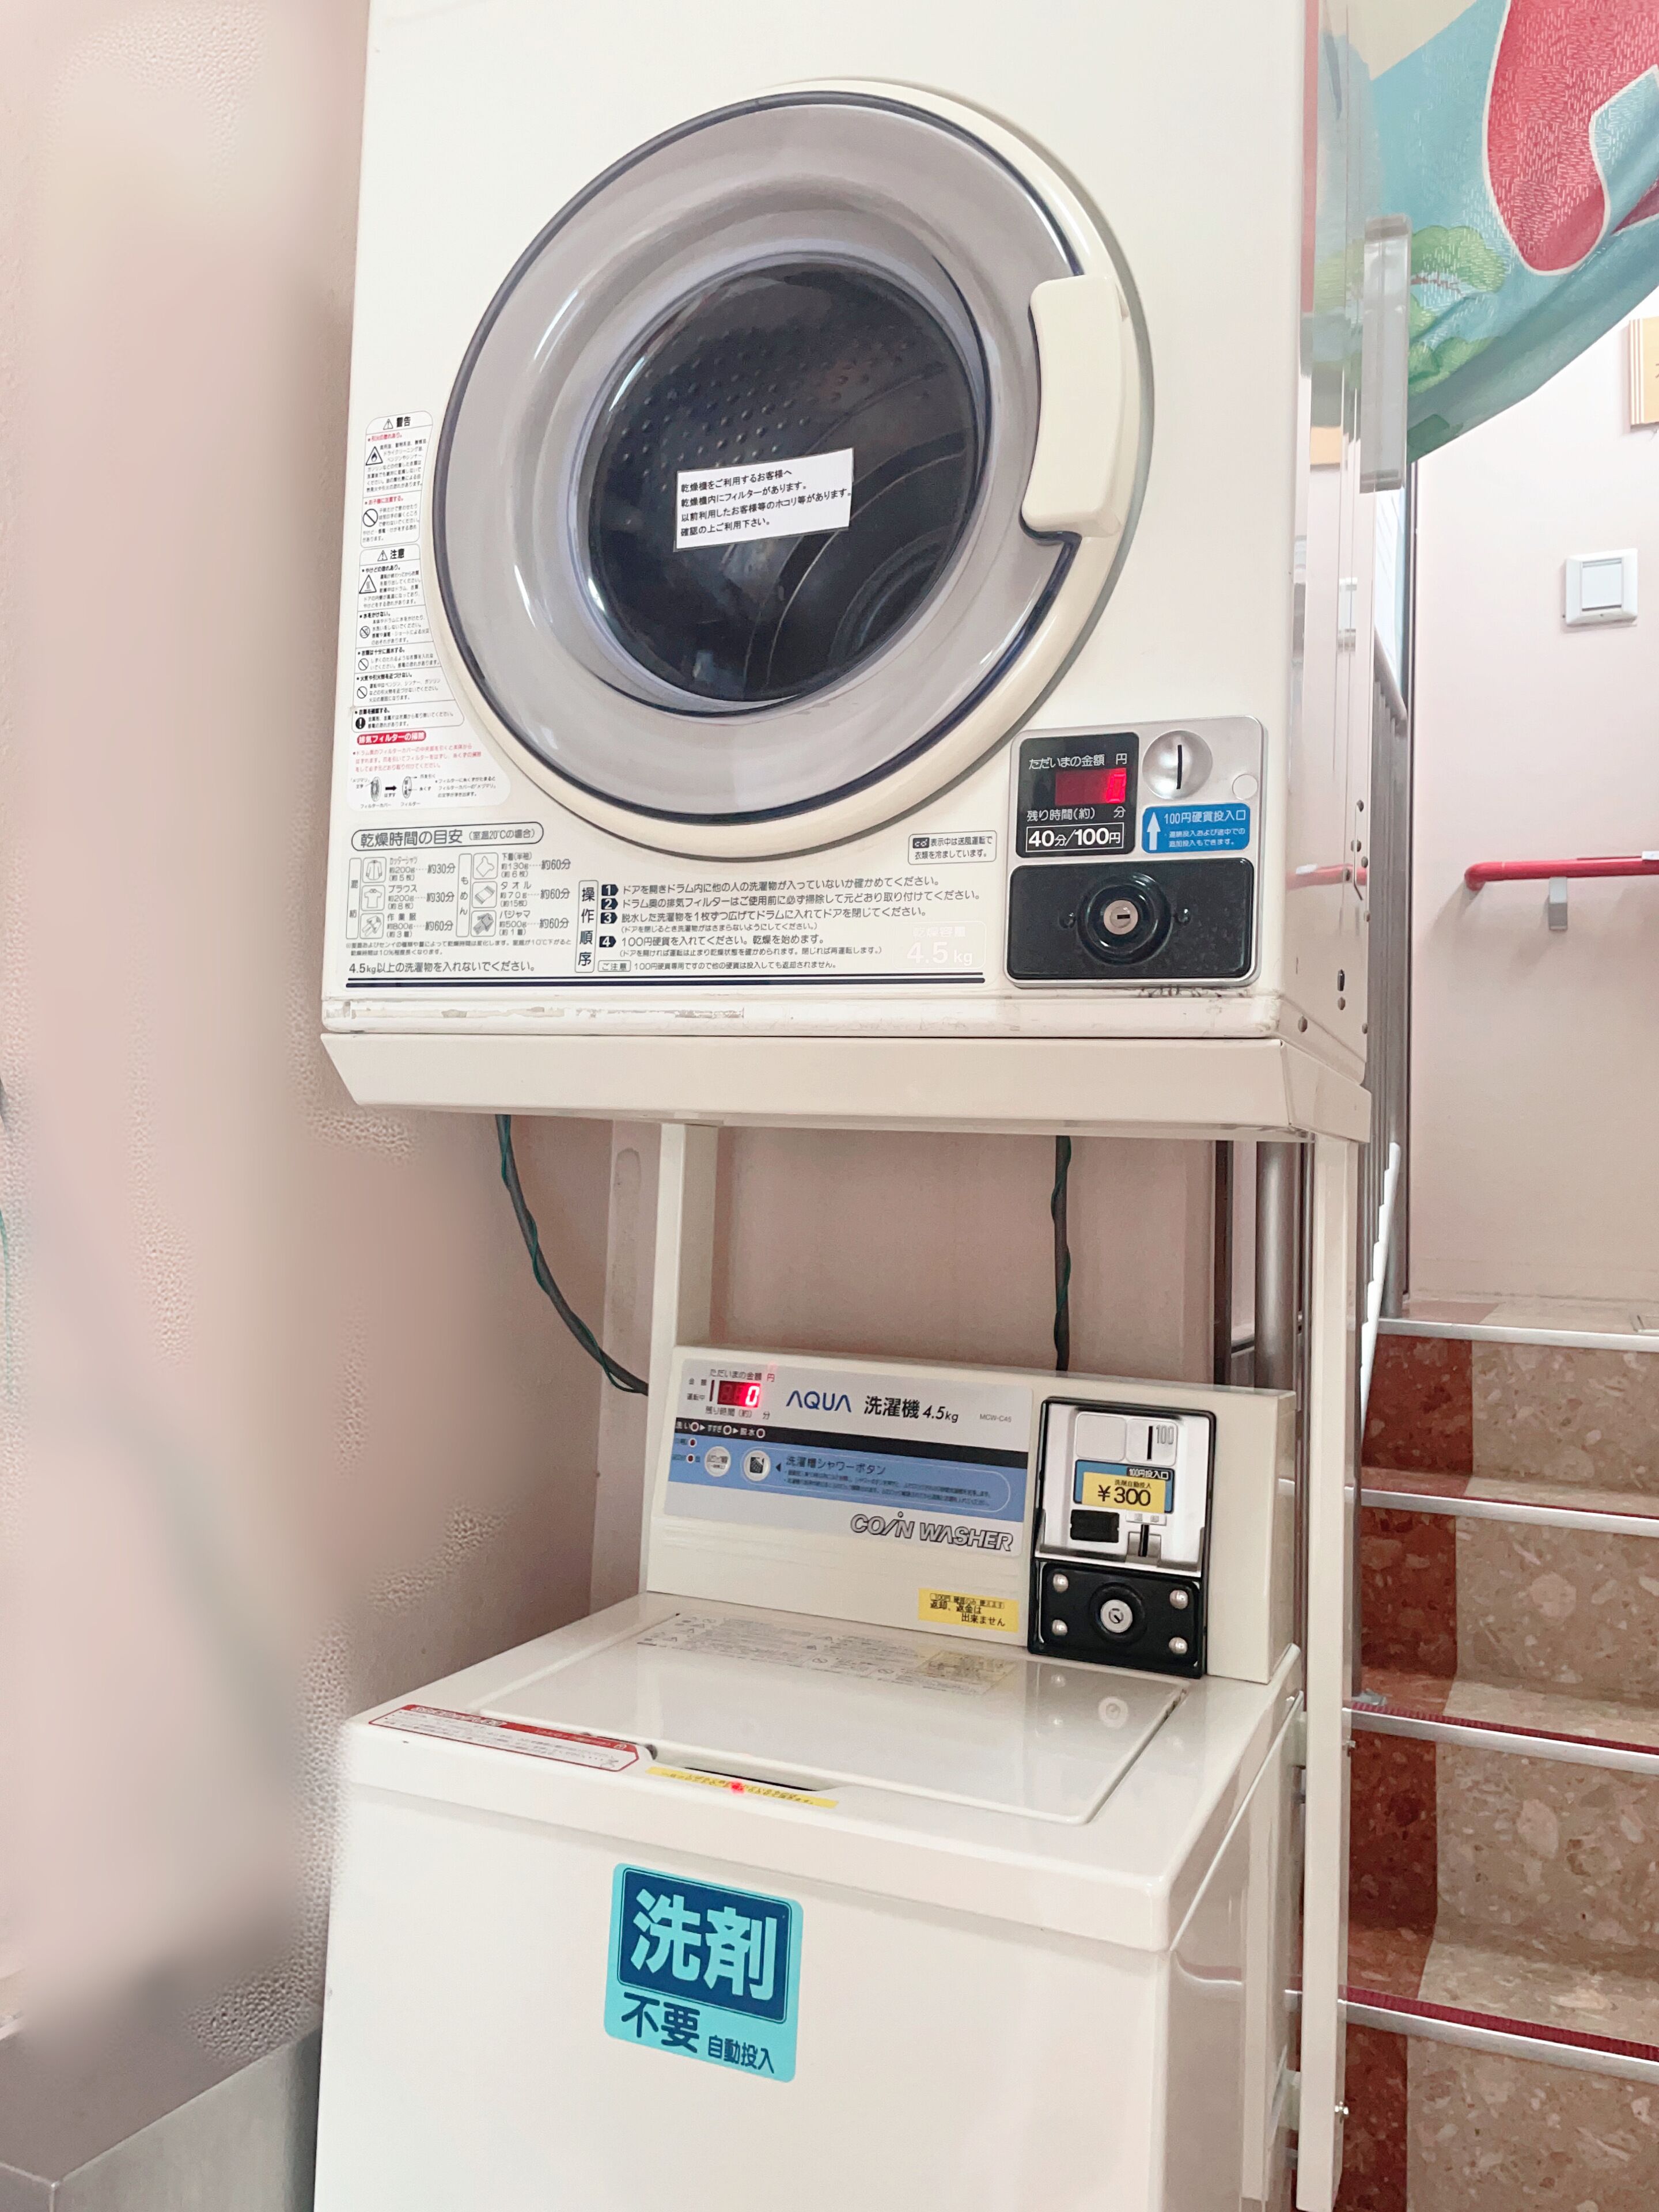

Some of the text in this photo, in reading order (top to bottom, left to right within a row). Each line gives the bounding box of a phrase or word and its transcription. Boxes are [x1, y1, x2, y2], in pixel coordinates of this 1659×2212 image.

[680, 469, 792, 493] 乾燥機をご利用するお客様へ
[680, 481, 806, 507] 乾燥機内にフィルターがあります。
[681, 488, 851, 521] 以前利用したお客様等のホコリ等があります。
[680, 518, 770, 537] 確認の上ご利用下さい。
[390, 548, 404, 559] 注意
[1028, 753, 1127, 770] ただいまの金額 円
[1027, 806, 1126, 821] 残り時間(約) 分
[1164, 810, 1245, 824] 100円硬貨投入口
[361, 829, 463, 849] 乾燥時間の目安
[930, 836, 993, 846] 表示中は送風運転で
[1028, 828, 1121, 847] 40分/100円
[915, 849, 986, 860] 衣類を冷ましています。
[427, 863, 456, 874] 約30分
[541, 858, 571, 870] 約60分
[388, 884, 417, 893] ブラウス
[501, 881, 532, 889] タオル
[623, 876, 939, 895] ドアを開きドラム内に他の人の洗濯物が入っていないか確かめてください。
[426, 892, 454, 903] 約30分
[460, 877, 468, 915] もめん
[540, 888, 570, 899] 約60分
[623, 890, 979, 908] ドラム奥の排気フィルターはご使用前に必ず掃除して元どおり取り付けてください。
[622, 907, 926, 922] 脱水した洗濯物を1枚ずつ広げてドラムに入れてドアを閉じてください。
[425, 920, 453, 931] 約60分
[539, 918, 569, 929] 約60分
[578, 887, 595, 966] 操作順序
[622, 934, 823, 946] 100円硬貨を入れてください。乾燥を始めます。
[907, 941, 973, 965] 4.5 kg
[349, 960, 536, 975] 4.5kg以上の洗濯物を入れないでください。
[601, 963, 627, 971] ご注意
[710, 1369, 775, 1382] ただいまの金額 円
[745, 1386, 759, 1406] 0
[786, 1390, 851, 1412] AQUA
[763, 1411, 770, 1419] 分
[864, 1395, 1012, 1423] 洗濯機 4.5kg MCW-C45
[1156, 1425, 1174, 1445] 100
[1098, 1485, 1150, 1506] ¥300
[850, 1512, 1013, 1551] COIN WASHER
[961, 1613, 1005, 1627] 出来ません
[630, 1888, 777, 2001] 洗剤
[621, 1992, 775, 2074] 不要 自動投入
